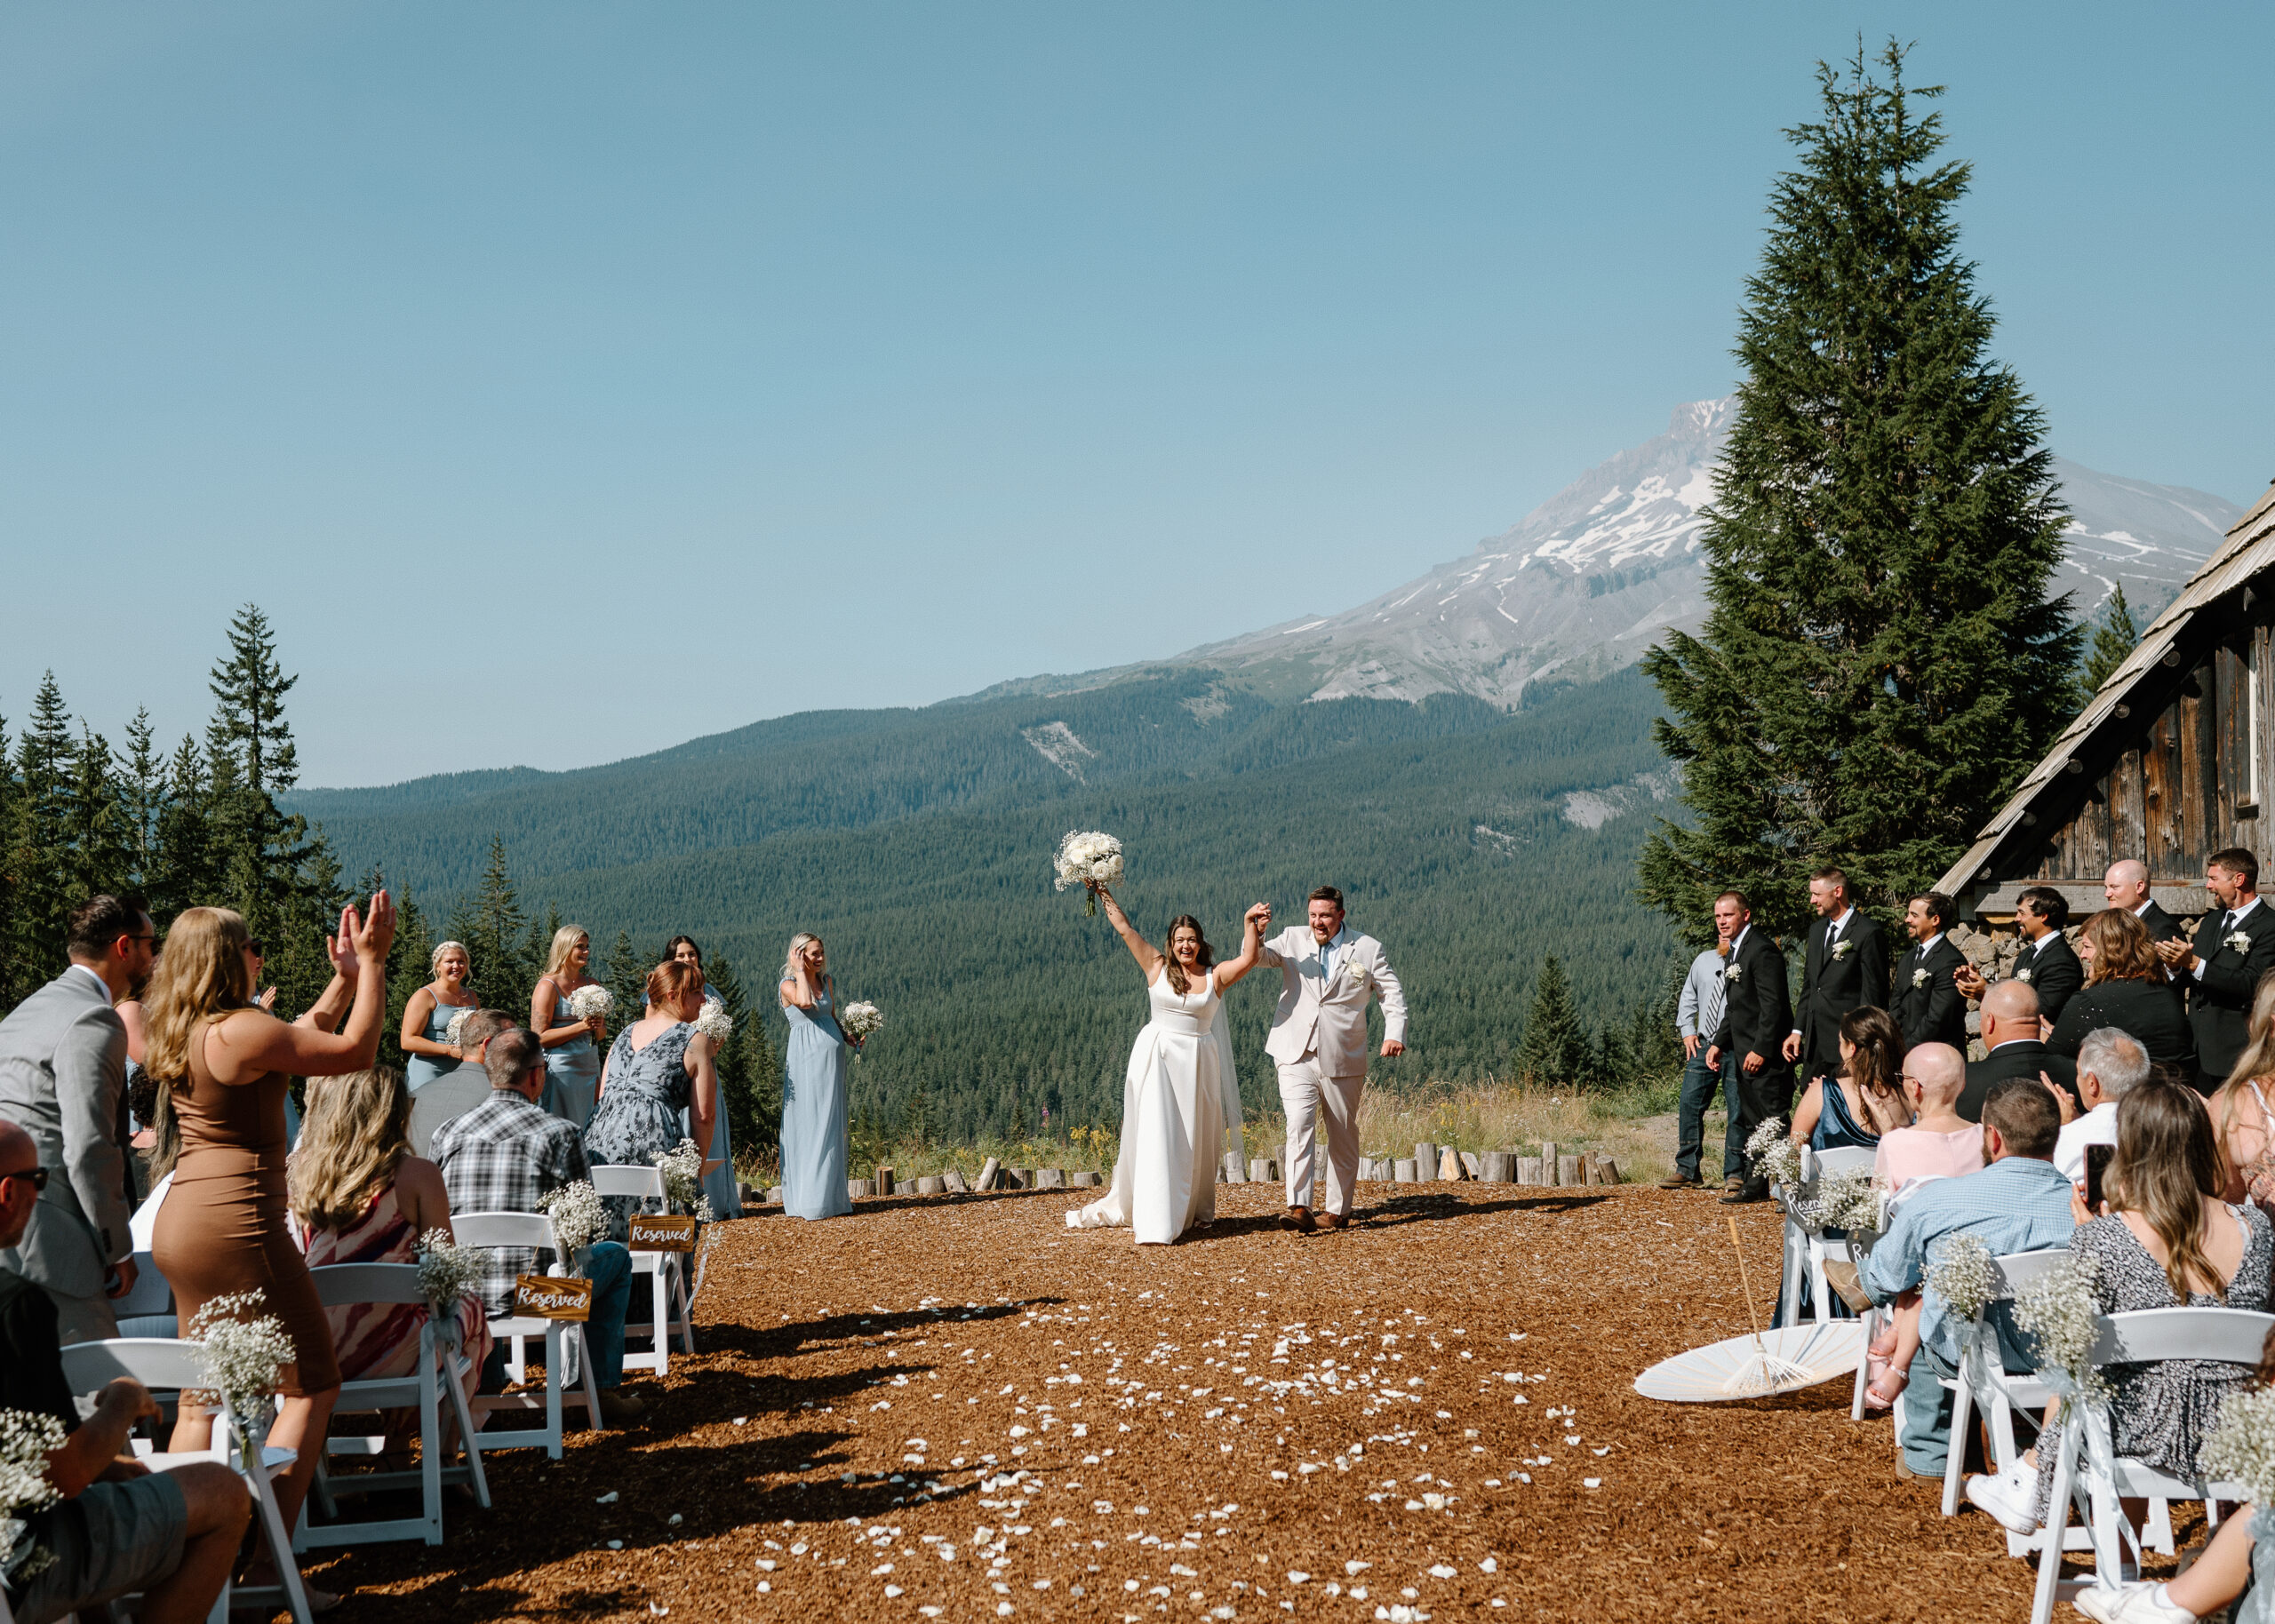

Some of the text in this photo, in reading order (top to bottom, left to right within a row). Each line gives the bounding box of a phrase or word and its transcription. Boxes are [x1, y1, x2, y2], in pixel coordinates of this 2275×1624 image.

[1784, 1191, 1822, 1221] Reser
[632, 1225, 691, 1243] Reserved
[517, 1286, 588, 1309] Reserved
